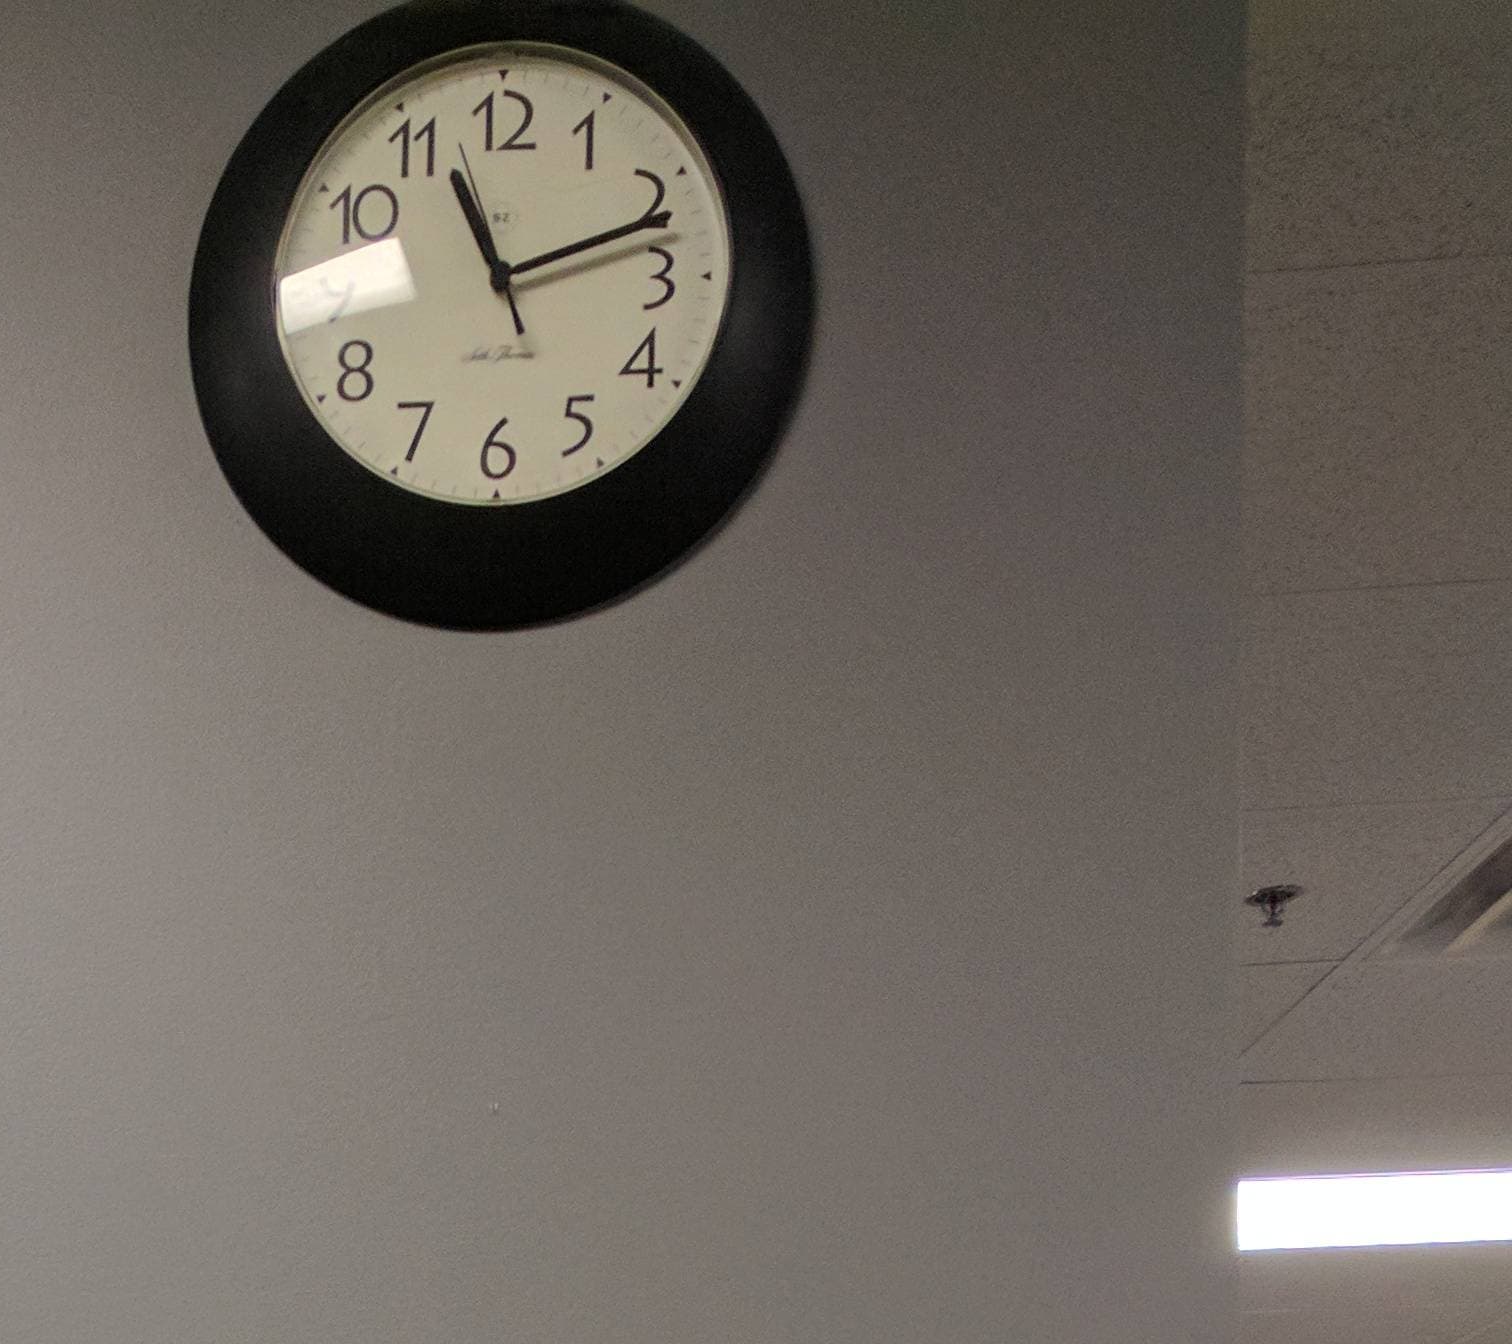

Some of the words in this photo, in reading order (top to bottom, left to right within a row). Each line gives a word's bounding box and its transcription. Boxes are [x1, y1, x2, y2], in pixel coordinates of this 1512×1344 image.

[389, 115, 436, 178] 11
[472, 90, 537, 151] 12
[572, 109, 595, 170] 1
[330, 183, 399, 244] 10
[634, 168, 669, 224] 2
[643, 246, 676, 310] 3
[336, 340, 374, 401] 8
[618, 327, 663, 388] 4
[397, 401, 435, 462] 7
[479, 417, 517, 480] 6
[561, 394, 595, 457] 5
